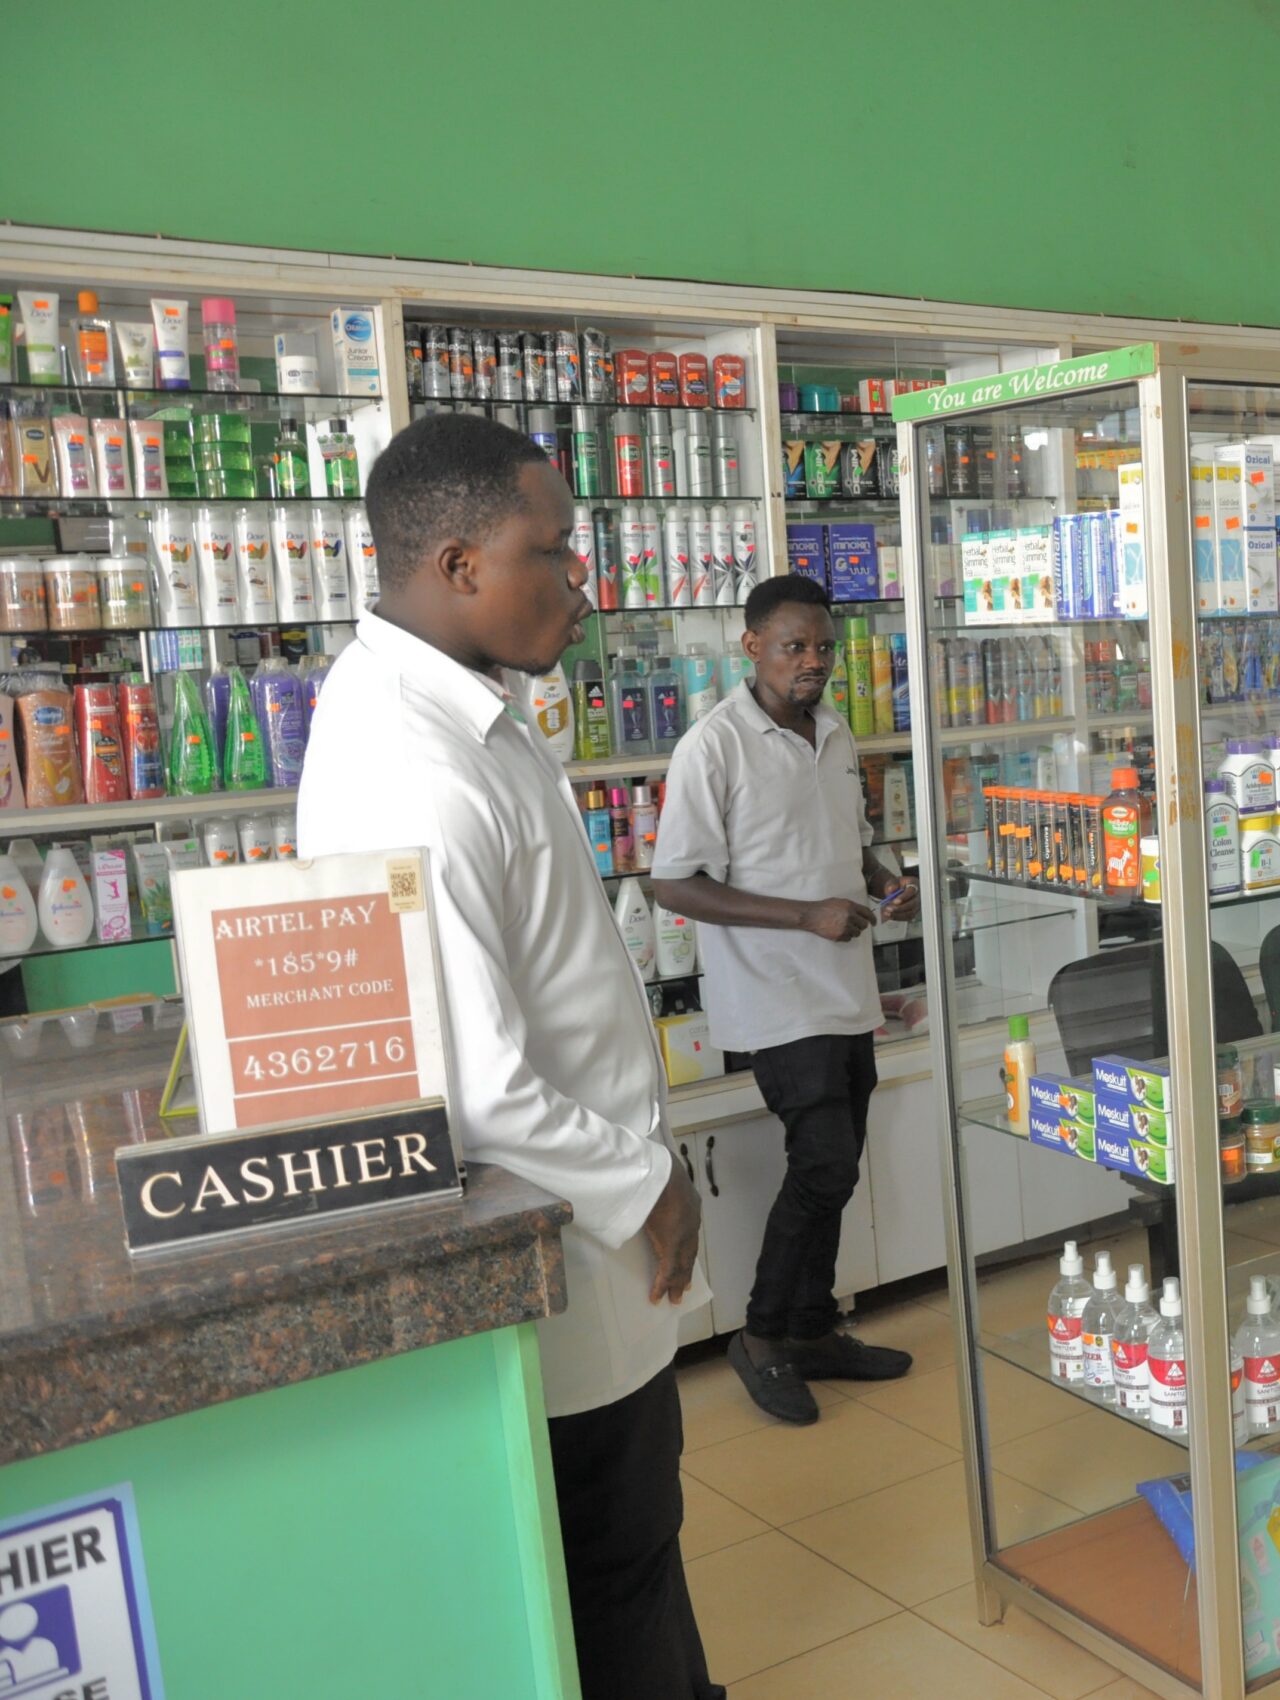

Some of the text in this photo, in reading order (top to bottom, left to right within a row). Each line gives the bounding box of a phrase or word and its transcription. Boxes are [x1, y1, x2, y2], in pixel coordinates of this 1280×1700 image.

[928, 361, 1109, 412] You are Welcome
[1245, 454, 1271, 464] Ozical
[1248, 540, 1273, 549] Ozical
[544, 690, 561, 699] Dove
[1210, 847, 1235, 858] Cleanse
[1212, 838, 1232, 847] Colon
[215, 900, 377, 940] AIRTEL PAY
[246, 978, 395, 1009] MERCHANT CODE
[242, 1035, 406, 1081] 4362716
[139, 1130, 438, 1220] CASHIER
